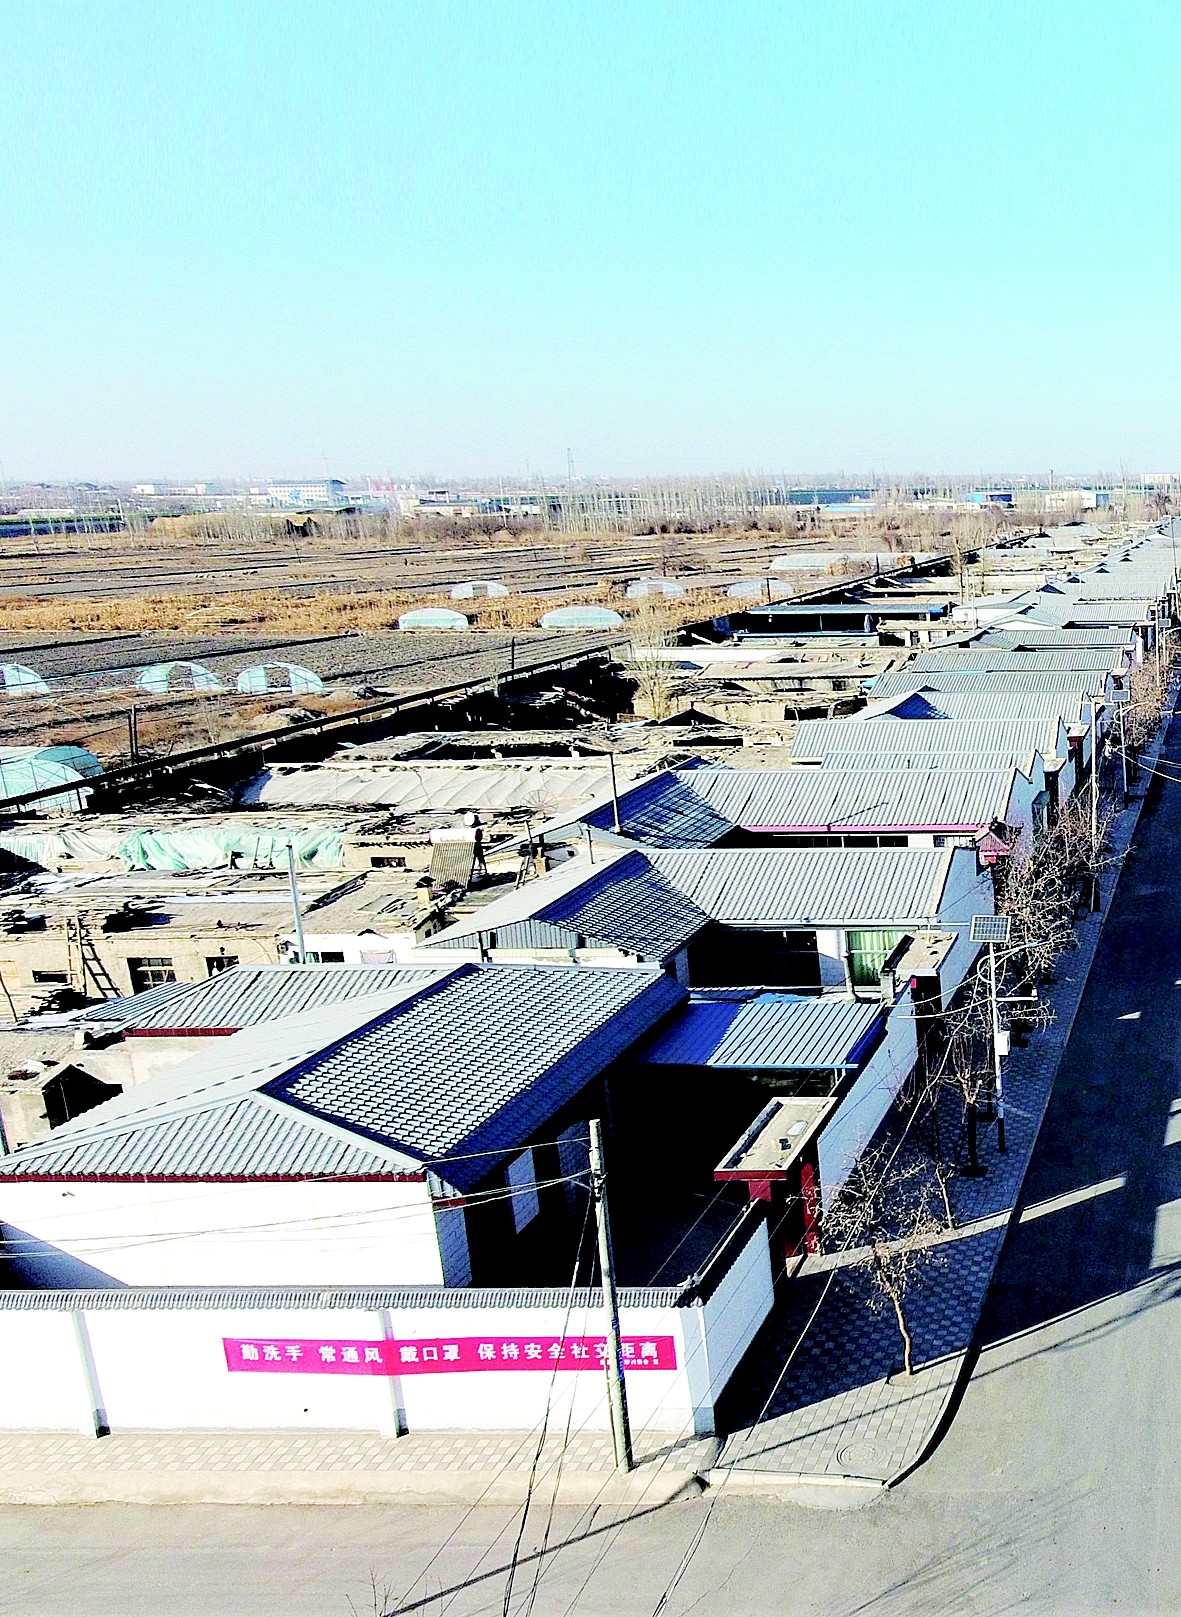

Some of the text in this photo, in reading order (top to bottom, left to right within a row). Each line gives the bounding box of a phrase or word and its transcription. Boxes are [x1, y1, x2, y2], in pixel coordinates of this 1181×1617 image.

[240, 1341, 659, 1364] 勤洗手 常通风 戴口罩 保持安全社交距离
